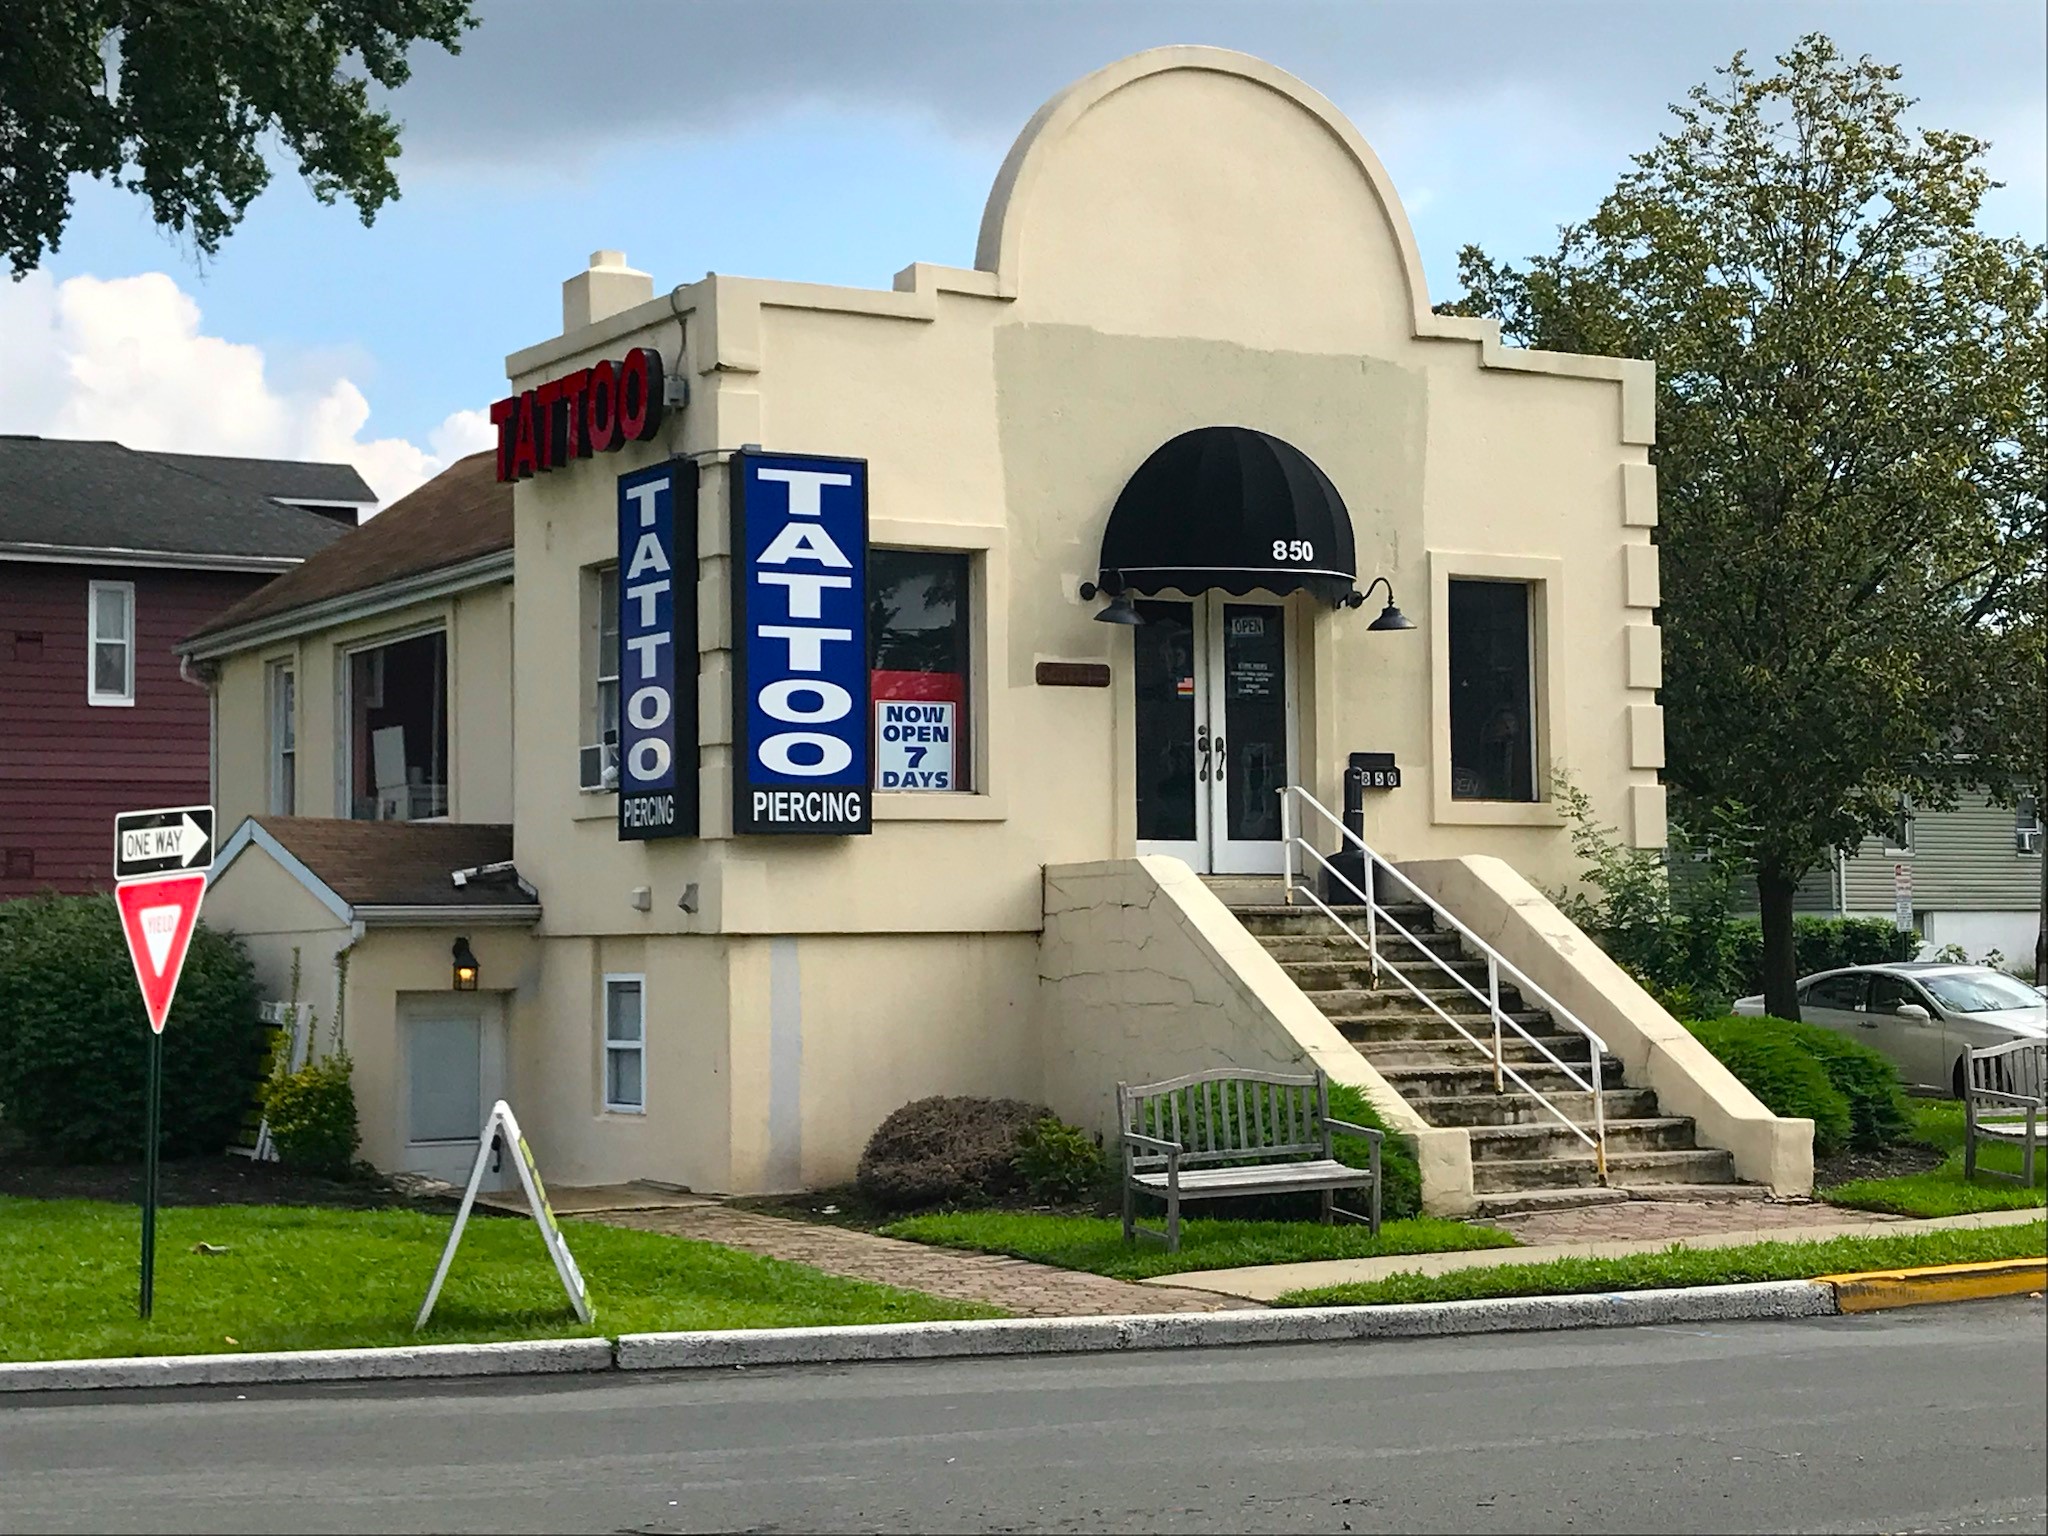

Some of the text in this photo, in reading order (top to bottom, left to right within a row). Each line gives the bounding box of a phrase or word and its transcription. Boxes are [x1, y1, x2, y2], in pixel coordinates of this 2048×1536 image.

[490, 346, 657, 481] TATTOO
[1272, 540, 1314, 561] 850
[626, 477, 671, 781] TATTOO
[756, 468, 854, 776] TATTOO
[1235, 619, 1262, 633] OPEN
[886, 706, 945, 723] NOW
[883, 725, 949, 742] OPEN
[904, 746, 928, 768] 7
[883, 771, 948, 788] DAYS
[1363, 773, 1396, 785] 850
[624, 796, 675, 828] PIERCING
[753, 792, 861, 823] PIERCING
[126, 829, 183, 857] ONE WAY
[148, 915, 174, 934] YIELD
